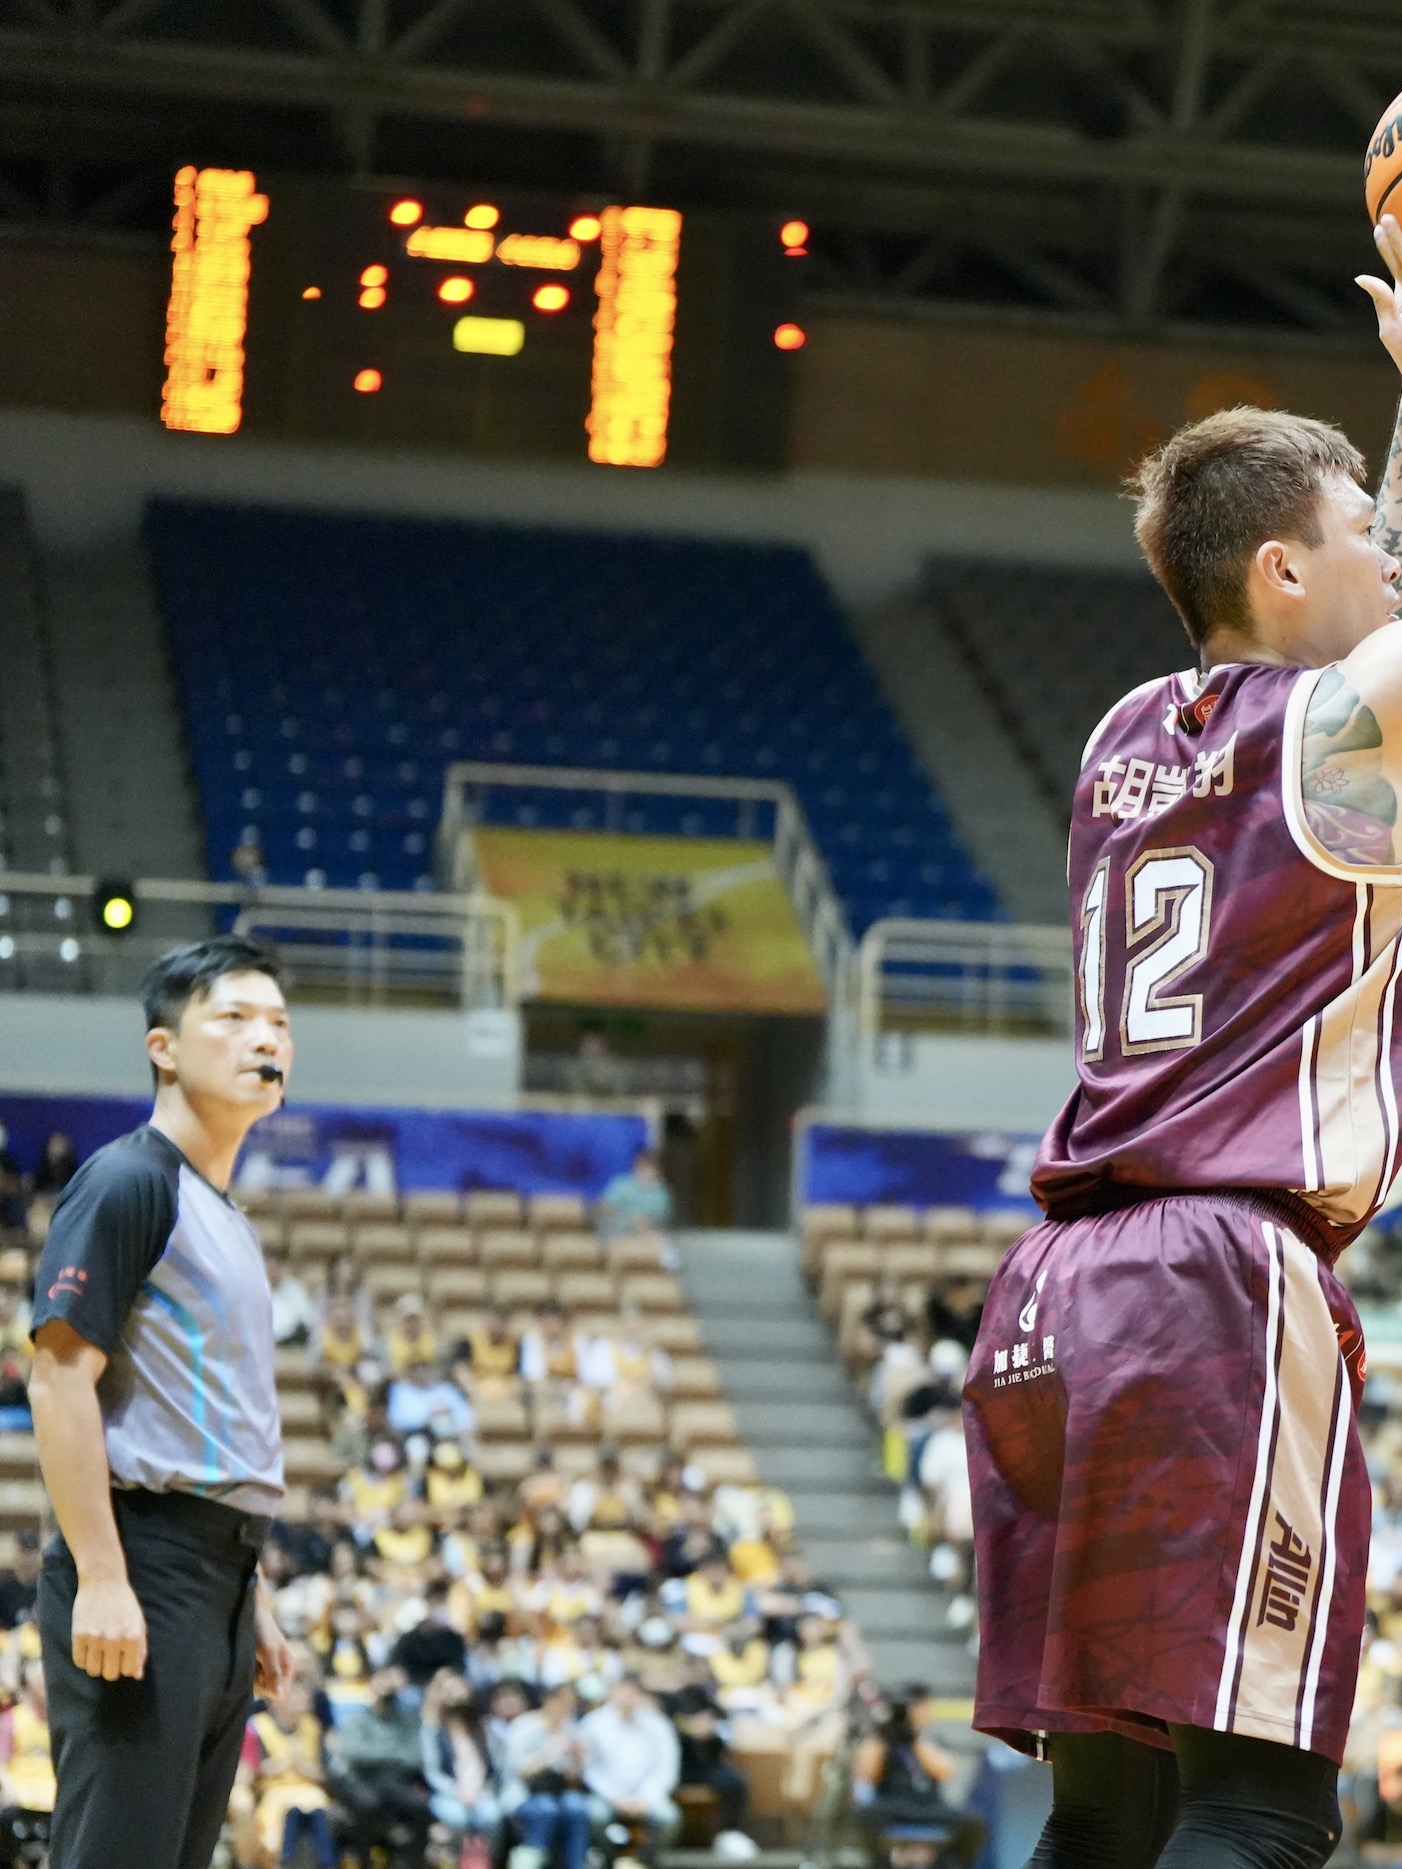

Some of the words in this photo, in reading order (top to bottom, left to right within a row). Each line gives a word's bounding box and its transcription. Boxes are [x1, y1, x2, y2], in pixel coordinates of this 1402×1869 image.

[1080, 845, 1215, 1064] 12
[993, 1376, 1007, 1389] JIA
[1007, 1372, 1022, 1385] JIE
